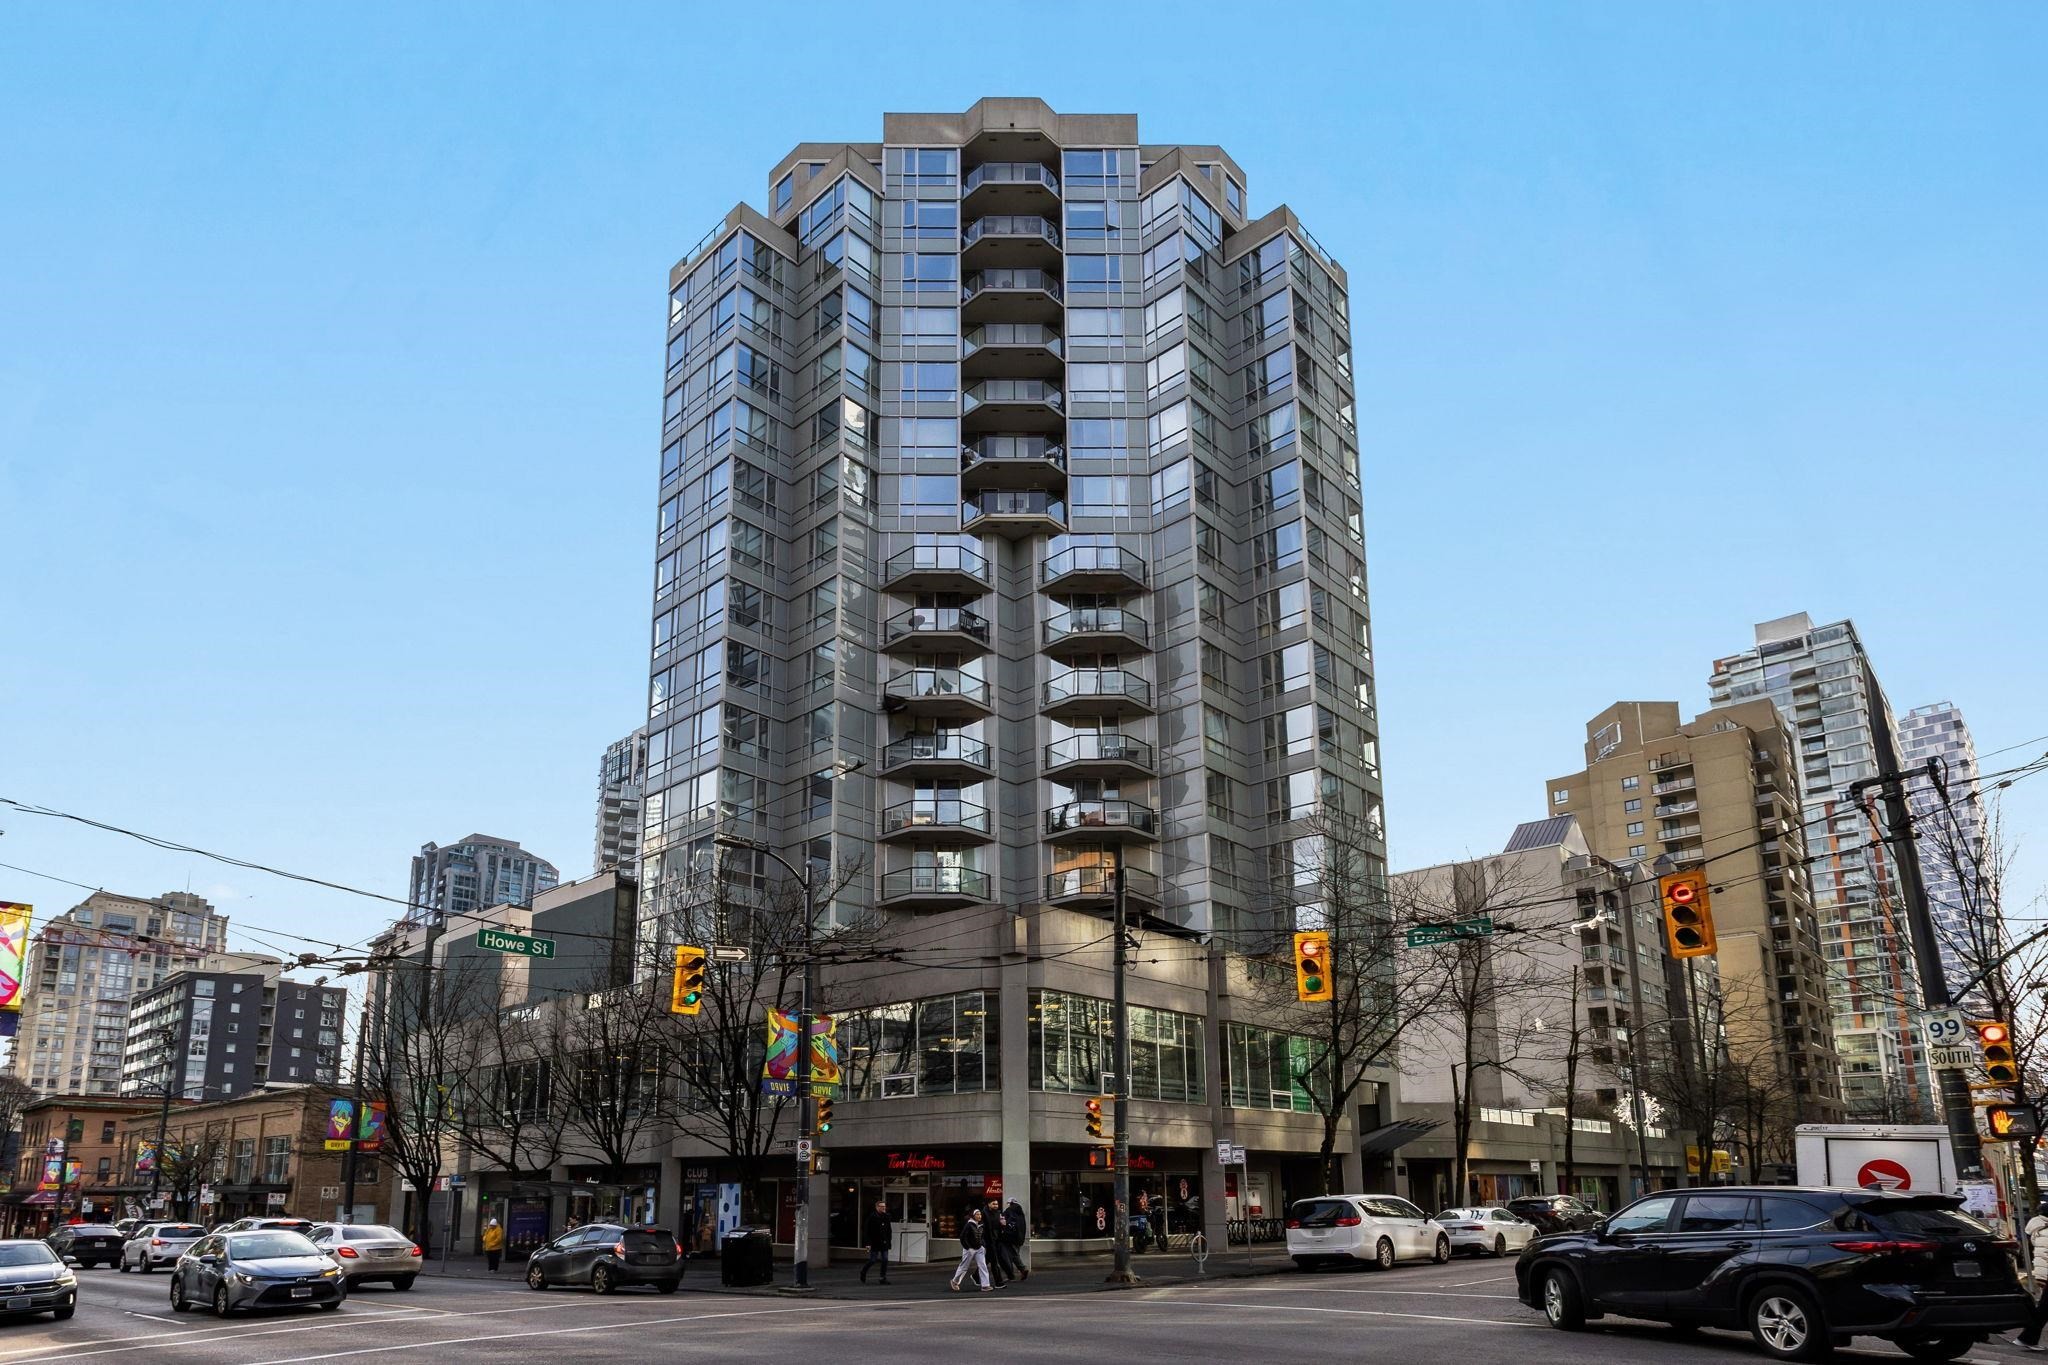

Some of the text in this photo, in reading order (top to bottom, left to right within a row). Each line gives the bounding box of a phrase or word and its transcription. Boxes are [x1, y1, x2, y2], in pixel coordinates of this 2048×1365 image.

[1414, 928, 1459, 943] Dav
[484, 933, 548, 955] Howe St
[1929, 1019, 1960, 1038] 99
[1931, 1051, 1970, 1065] SOUTH
[770, 1082, 790, 1092] DAVIE
[813, 1085, 832, 1096] DAVIE
[888, 1152, 945, 1169] Tim Hortons
[687, 1167, 708, 1178] CLUB
